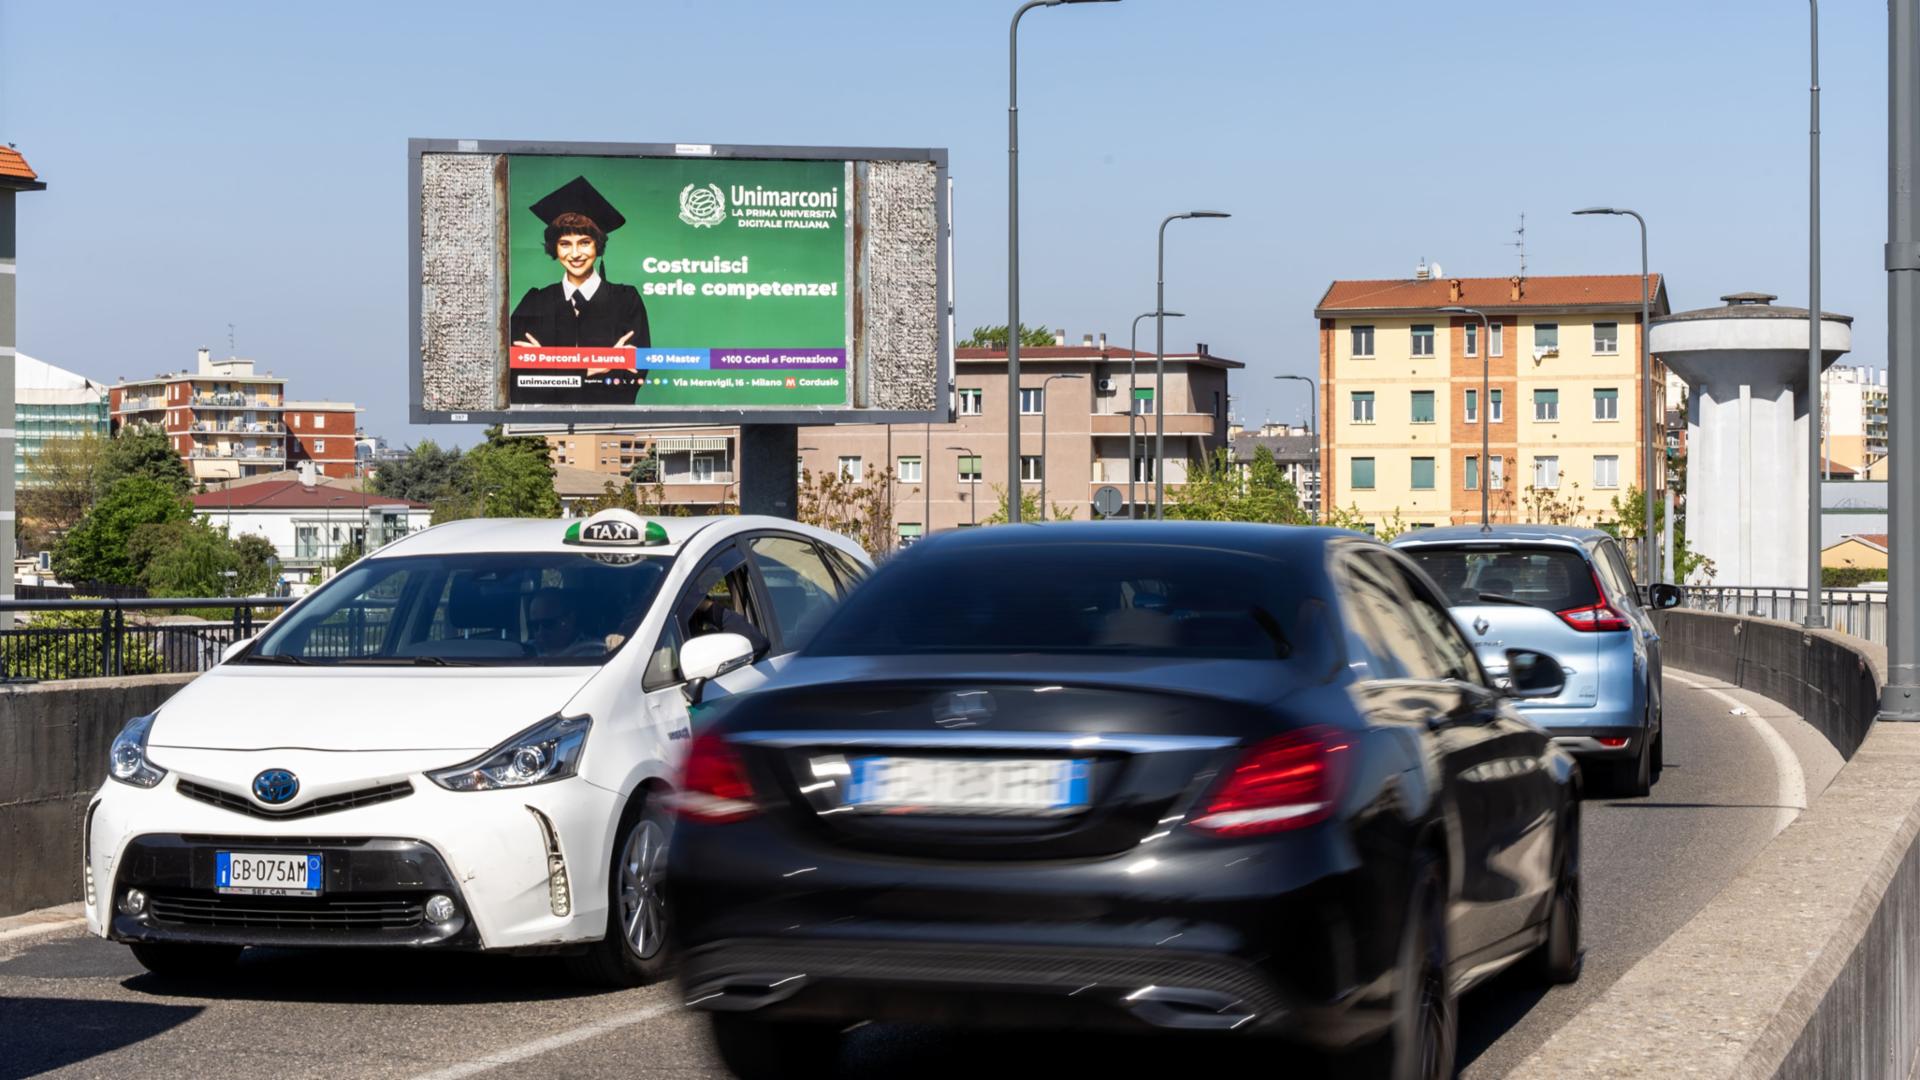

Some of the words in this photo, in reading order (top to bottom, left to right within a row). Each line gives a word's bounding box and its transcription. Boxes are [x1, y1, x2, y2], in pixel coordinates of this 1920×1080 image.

[731, 185, 837, 207] Unimarconi
[731, 208, 744, 217] LA
[746, 209, 778, 218] PRIMA
[779, 208, 837, 218] UNIVERSITÀ
[738, 219, 782, 228] DIGITALE
[784, 220, 830, 229] ITALIANA
[643, 256, 748, 273] Costruisci
[643, 279, 696, 296] serie
[701, 281, 838, 299] competenze!
[517, 354, 536, 363] +50
[538, 353, 580, 363] Percorsi
[591, 354, 625, 363] Laurea
[645, 354, 664, 363] +50
[666, 354, 701, 364] Master
[721, 355, 741, 364] +100
[744, 354, 770, 364] Corsi
[780, 354, 839, 364] Formazione
[519, 376, 580, 386] unimarconi.it
[673, 378, 688, 387] Via
[690, 378, 734, 388] Meravigli,
[735, 379, 744, 387] 16
[751, 378, 782, 387] Milano
[799, 378, 839, 387] Cordusio
[591, 524, 634, 539] TAXI
[269, 889, 287, 897] CAR
